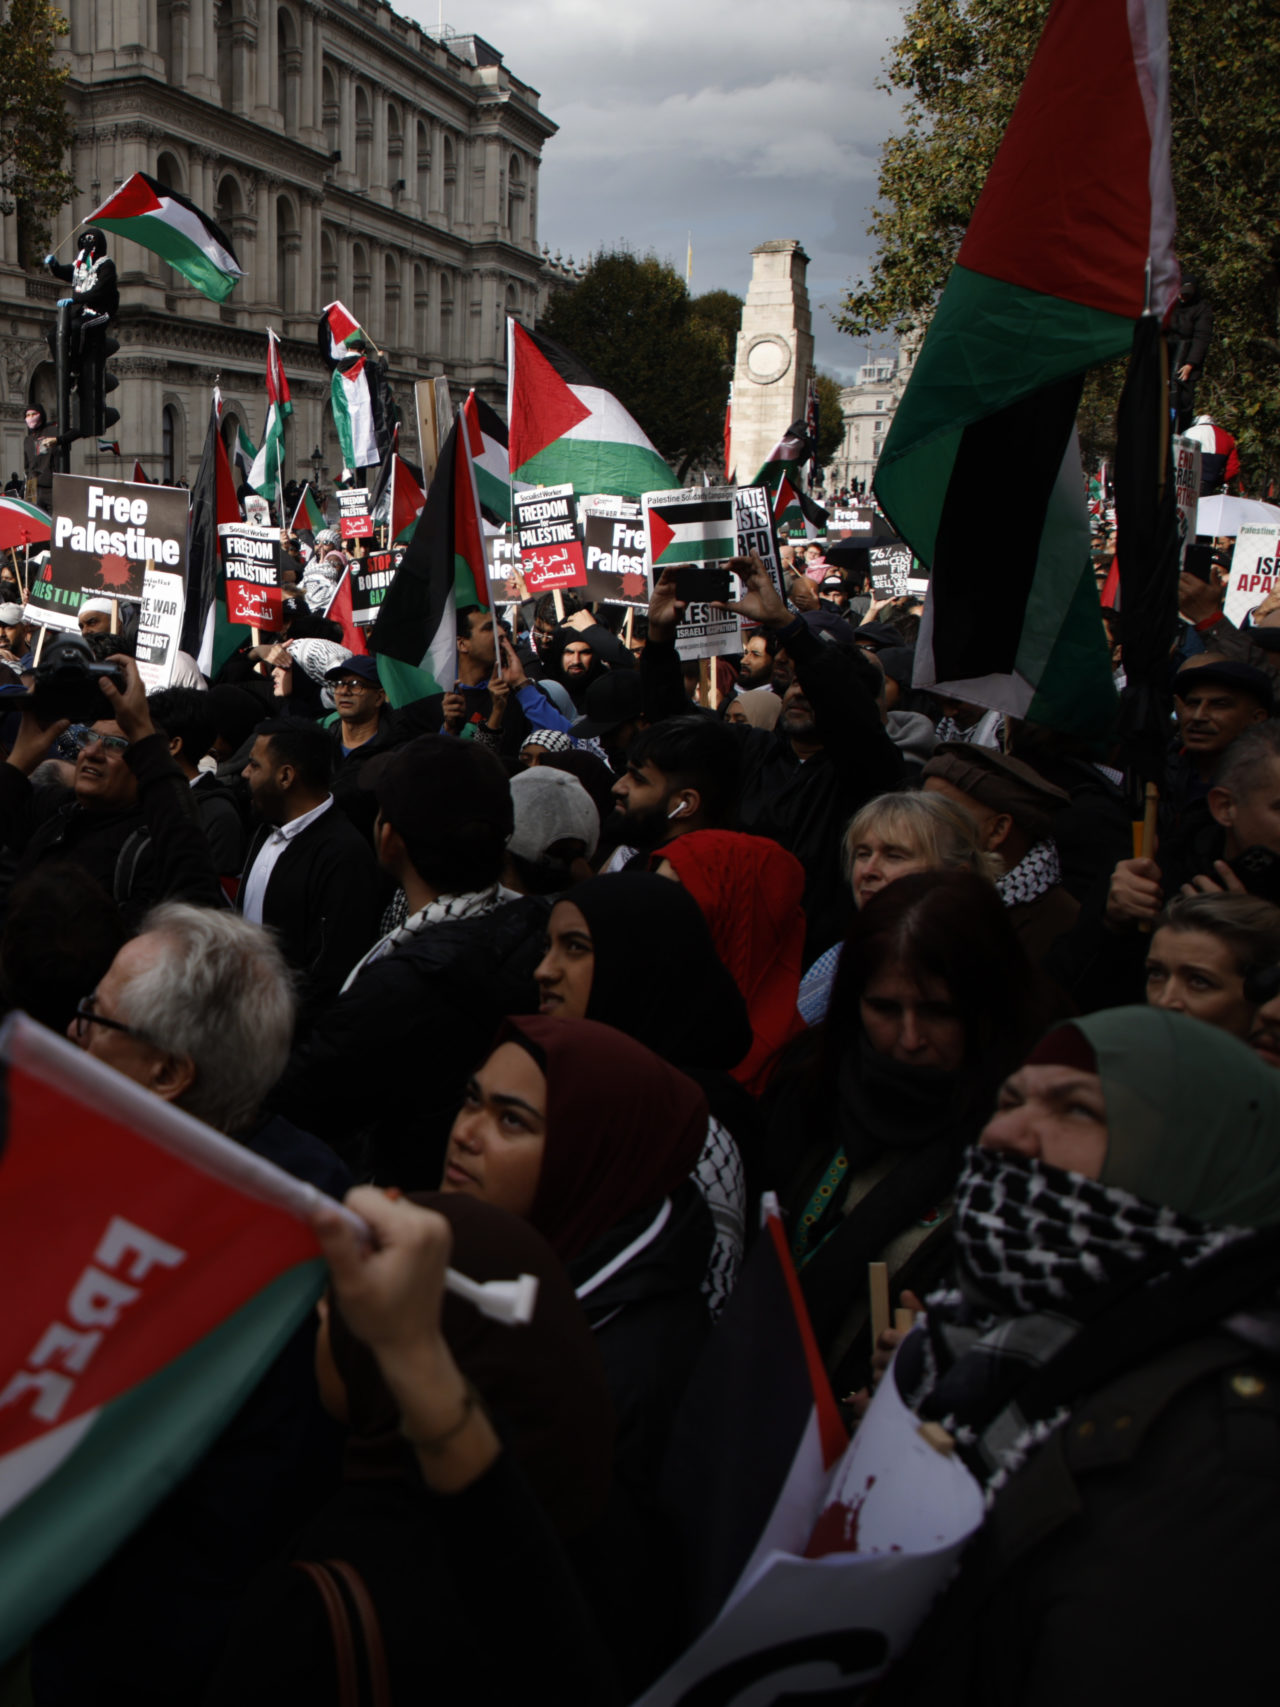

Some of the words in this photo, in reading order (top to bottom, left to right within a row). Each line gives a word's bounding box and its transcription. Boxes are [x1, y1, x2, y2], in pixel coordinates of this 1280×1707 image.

[88, 485, 148, 525] Free
[647, 493, 681, 505] Palestine
[519, 499, 569, 523] FREEDOM
[737, 508, 769, 531] ISTS
[834, 509, 859, 520] Free
[55, 516, 180, 565] Palestine
[520, 523, 576, 547] PALESTINE
[612, 522, 646, 550] Fre
[1240, 526, 1275, 536] Palestine
[226, 537, 273, 560] FREEDOM
[531, 548, 569, 567] الحرية
[870, 547, 892, 560] 76%
[367, 554, 392, 572] STOP
[586, 546, 649, 577] Palest
[369, 588, 387, 606] GAZ
[153, 599, 177, 616] WAR
[677, 626, 705, 638] ISRAELI
